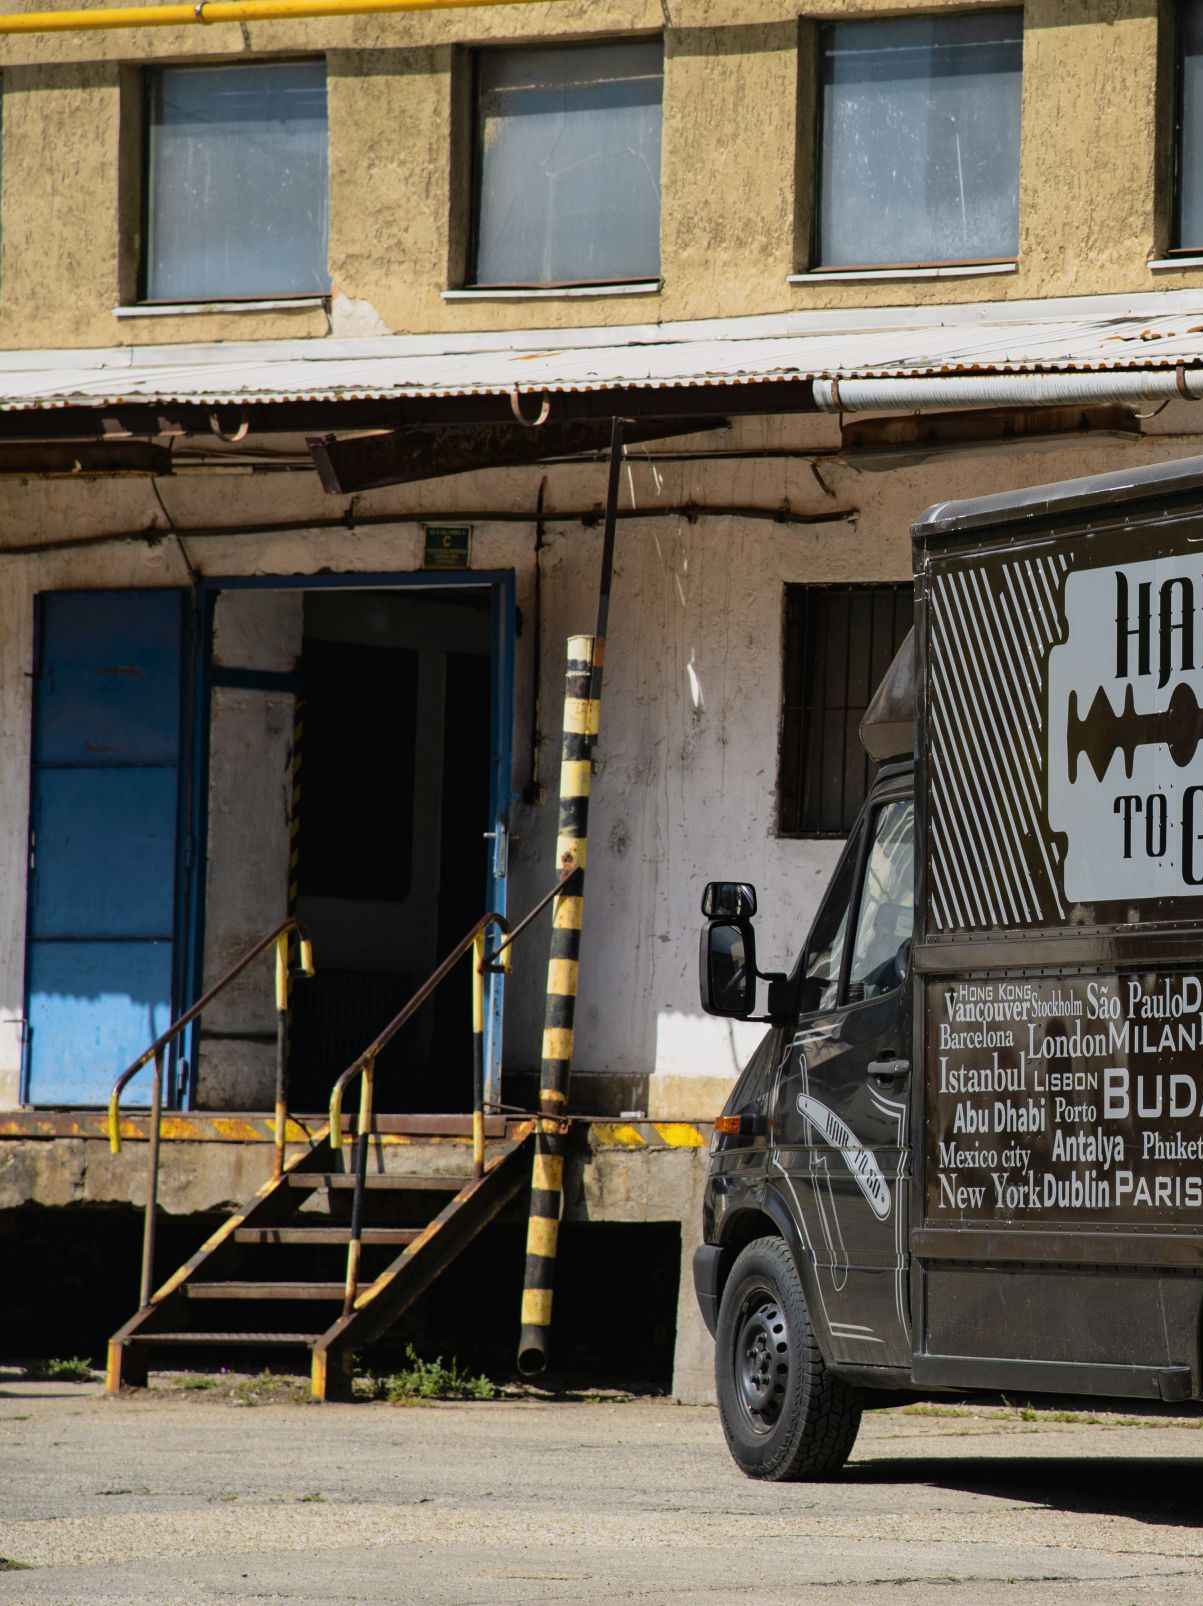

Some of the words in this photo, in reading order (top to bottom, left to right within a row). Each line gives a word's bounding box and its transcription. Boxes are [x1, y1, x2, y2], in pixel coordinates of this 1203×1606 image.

[1113, 793, 1168, 859] TO
[944, 992, 1031, 1023] Vancouver
[959, 985, 993, 1001] HONG
[999, 983, 1031, 1001] KONG
[1031, 989, 1083, 1018] Stockholm
[1086, 982, 1121, 1020] São
[1127, 978, 1183, 1019] Paulo
[939, 1021, 1014, 1050] Barcelona
[1027, 1019, 1109, 1059] London
[1108, 1021, 1197, 1054] MILAN
[938, 1051, 1027, 1094] Istanbul
[1034, 1070, 1098, 1092] LISBON
[953, 1100, 989, 1134] Abu
[994, 1097, 1046, 1133] Dhabi
[1054, 1097, 1097, 1123] Porto
[825, 1112, 849, 1149] HAIR
[1051, 1126, 1125, 1171] Antalya
[1142, 1131, 1203, 1160] Phuket
[938, 1140, 998, 1169] Mexico
[1002, 1140, 1031, 1176] city
[938, 1173, 986, 1209] New
[990, 1170, 1042, 1209] York
[1043, 1169, 1110, 1208] Dublin
[1115, 1170, 1203, 1208] PARIS
